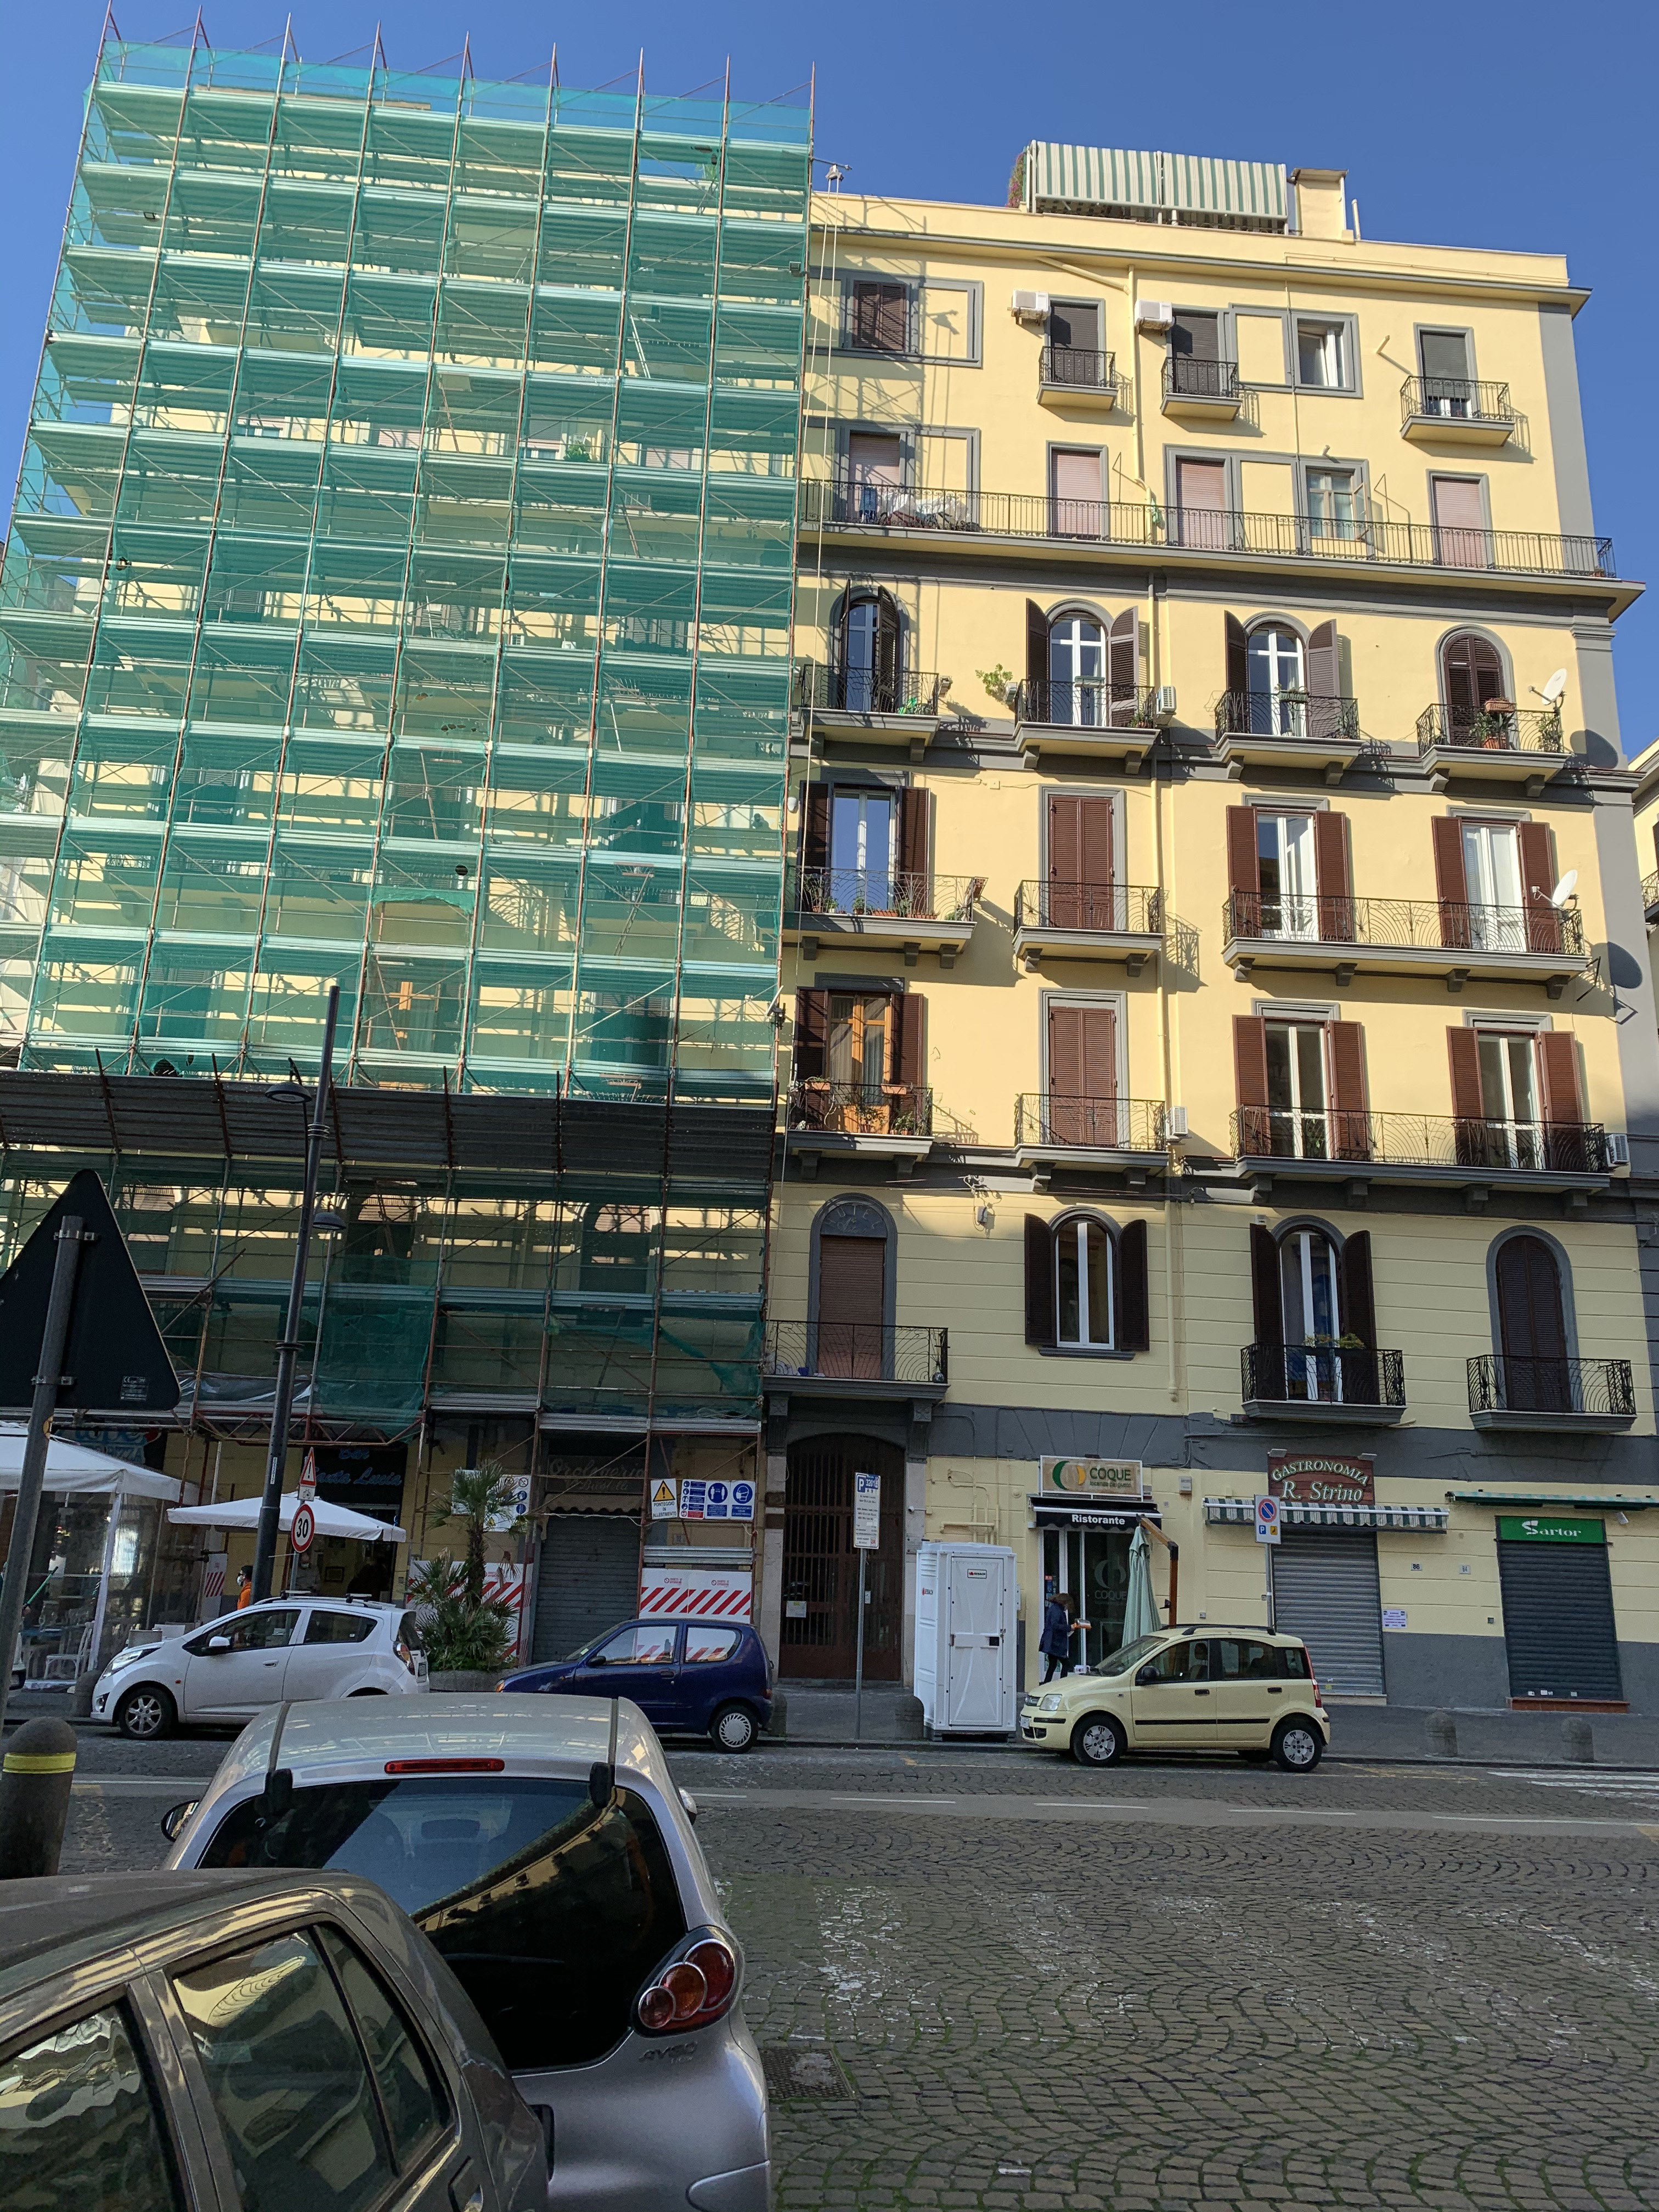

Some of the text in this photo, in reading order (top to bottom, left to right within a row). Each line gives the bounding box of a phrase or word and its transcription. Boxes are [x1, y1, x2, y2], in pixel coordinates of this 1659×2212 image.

[353, 1466, 402, 1486] Lucia
[1090, 1468, 1131, 1482] COQUE
[1272, 1460, 1369, 1486] GASTRONOMIA
[1281, 1480, 1363, 1502] R. Strino
[296, 1518, 309, 1538] 30
[1071, 1514, 1125, 1525] Ristorante
[1521, 1520, 1582, 1537] Sartor
[1094, 1590, 1127, 1601] COQUE
